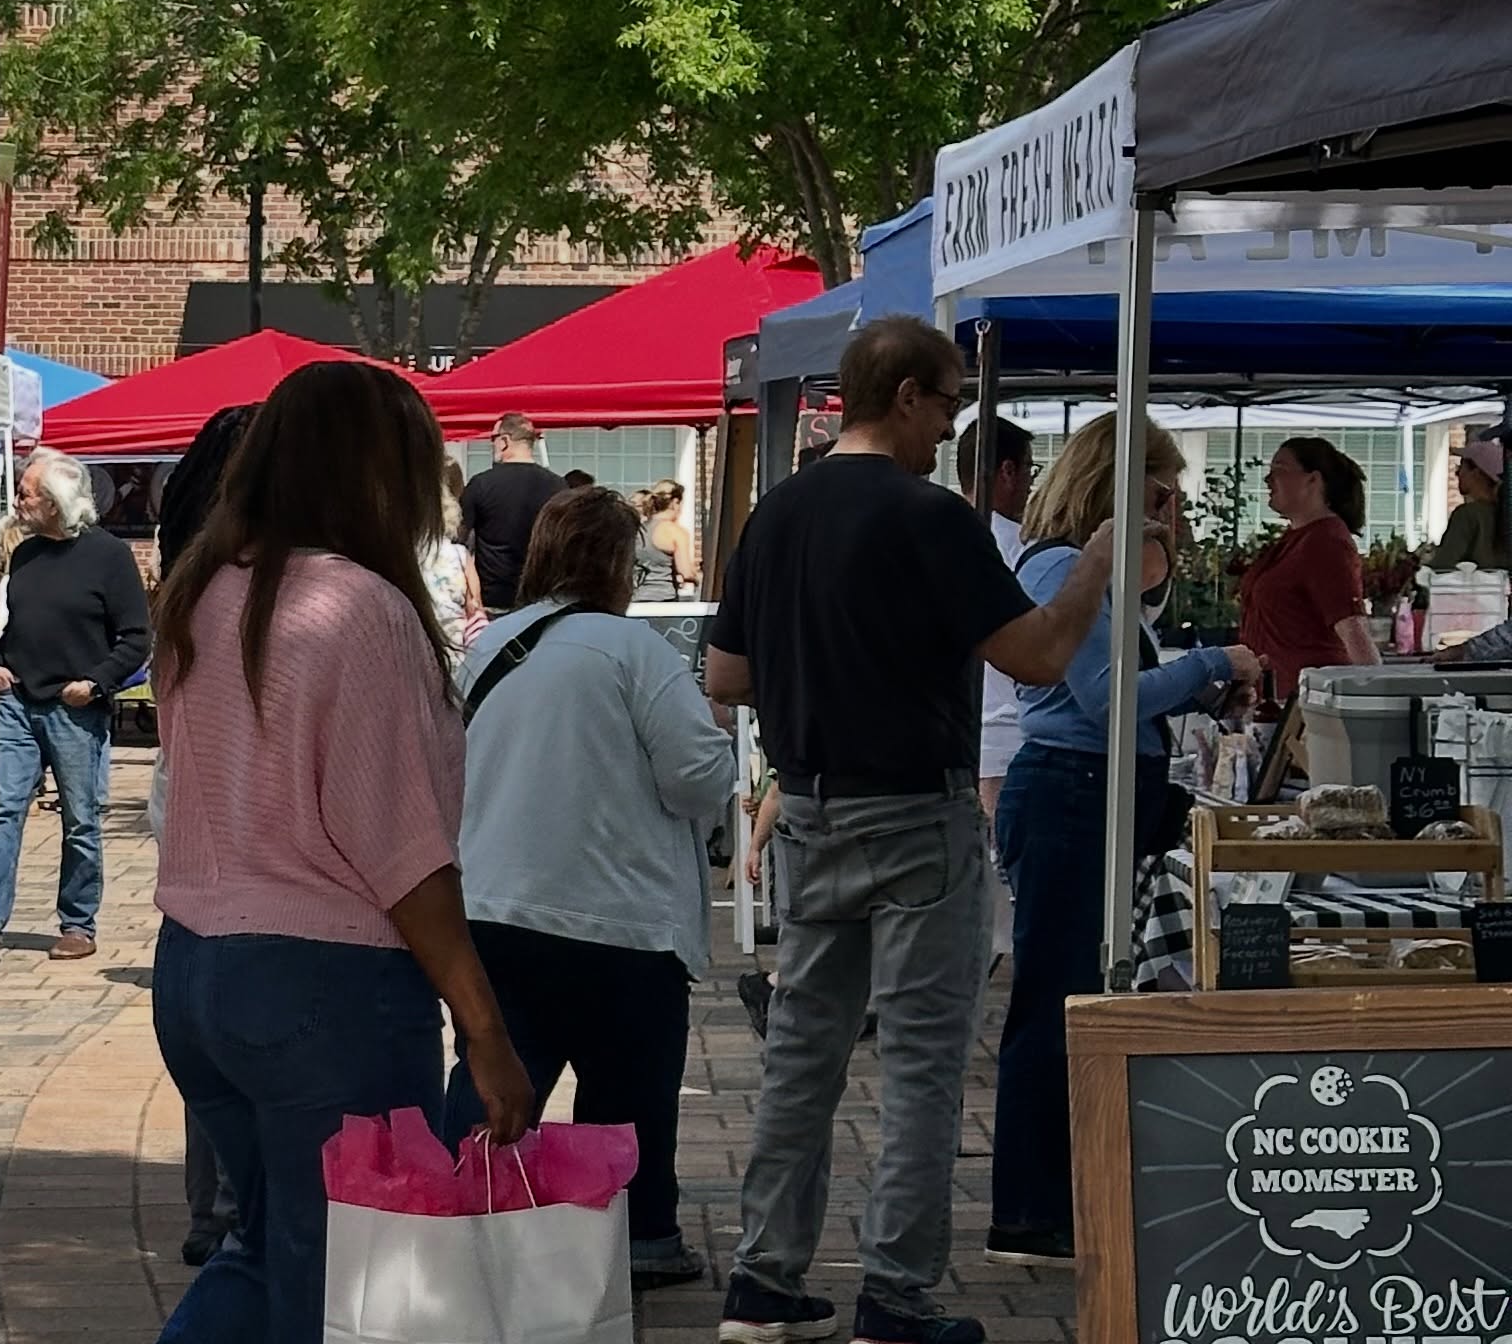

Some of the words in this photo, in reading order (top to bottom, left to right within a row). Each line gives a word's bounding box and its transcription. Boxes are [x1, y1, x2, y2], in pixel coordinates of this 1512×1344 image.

[942, 166, 989, 267] FARM
[1000, 131, 1054, 248] FRESH
[1062, 96, 1118, 225] MEATS
[1399, 767, 1427, 783] NY
[1399, 784, 1457, 798] Crumb
[1253, 1128, 1295, 1155] NC
[1300, 1127, 1410, 1154] COOKIE
[1251, 1167, 1419, 1193] MOMSTER
[1369, 1275, 1510, 1335] Best
